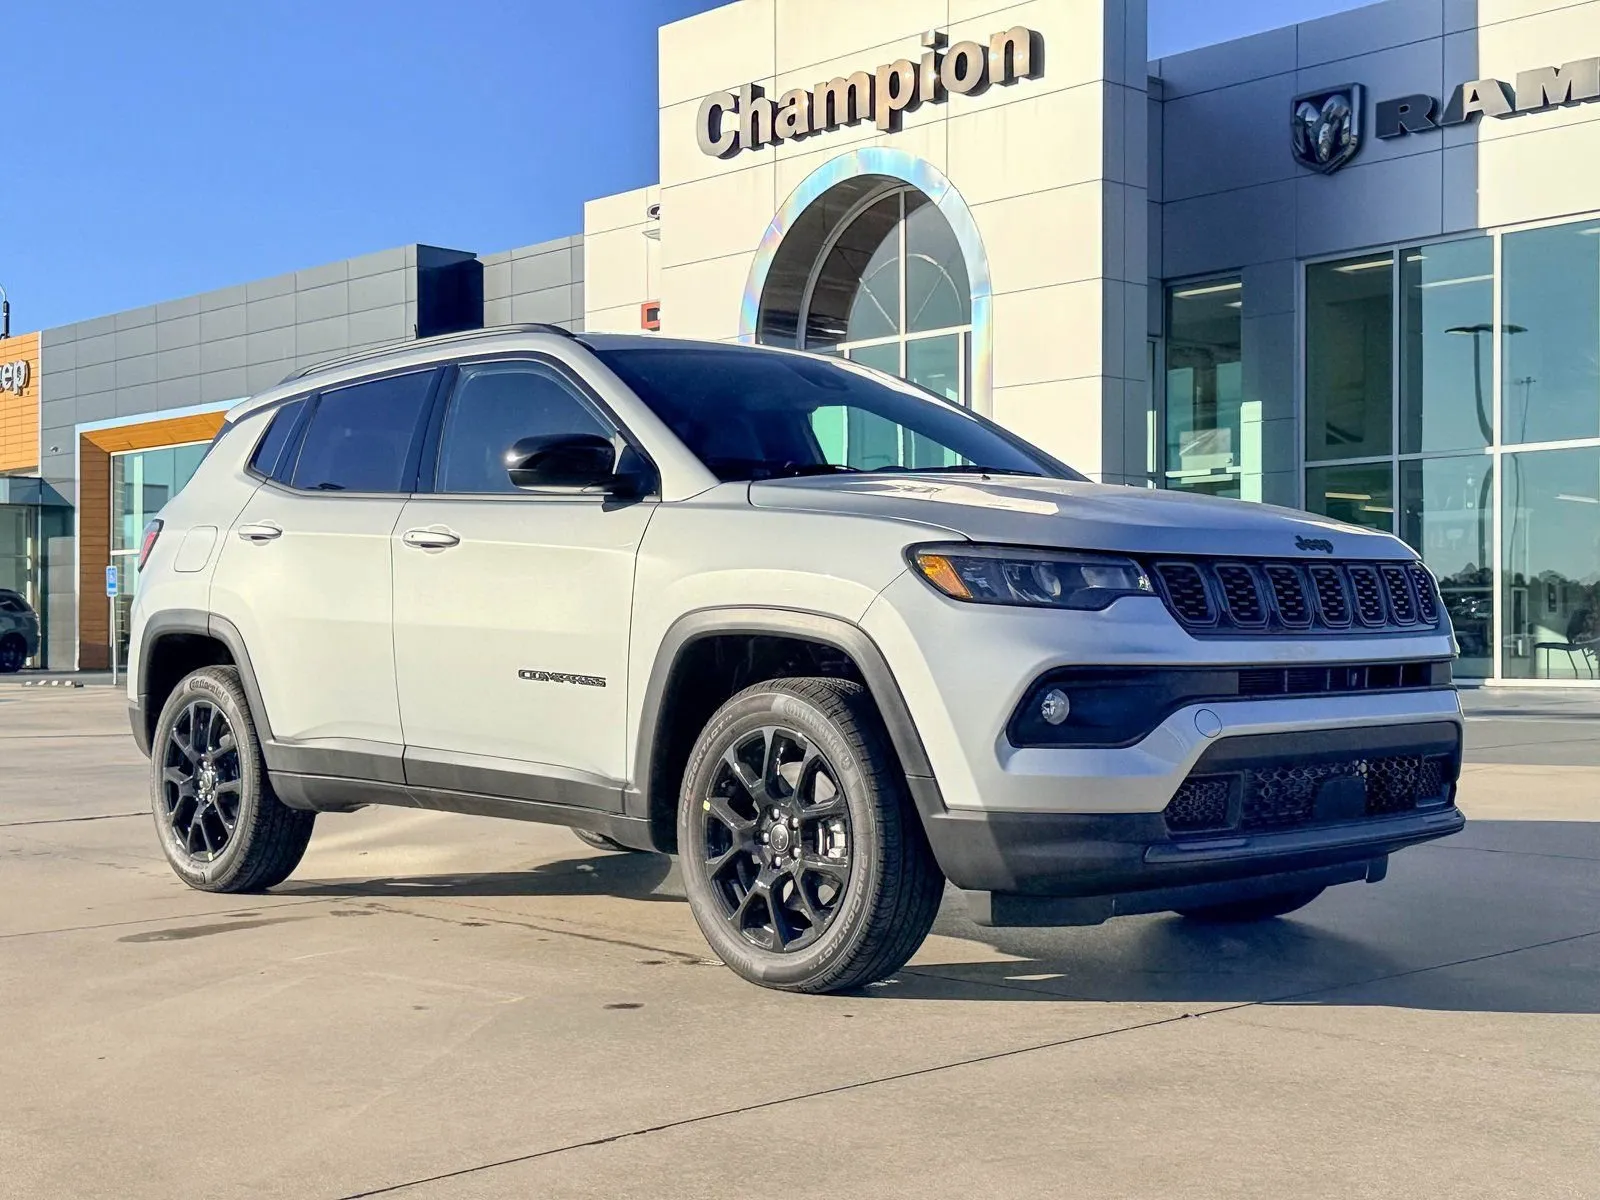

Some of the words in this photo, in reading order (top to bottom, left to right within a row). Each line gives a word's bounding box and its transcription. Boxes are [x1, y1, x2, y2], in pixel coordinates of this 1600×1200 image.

[696, 26, 1044, 160] Champion
[1376, 57, 1600, 139] RAM
[1295, 535, 1334, 554] Jeep
[518, 669, 606, 687] COMPASS
